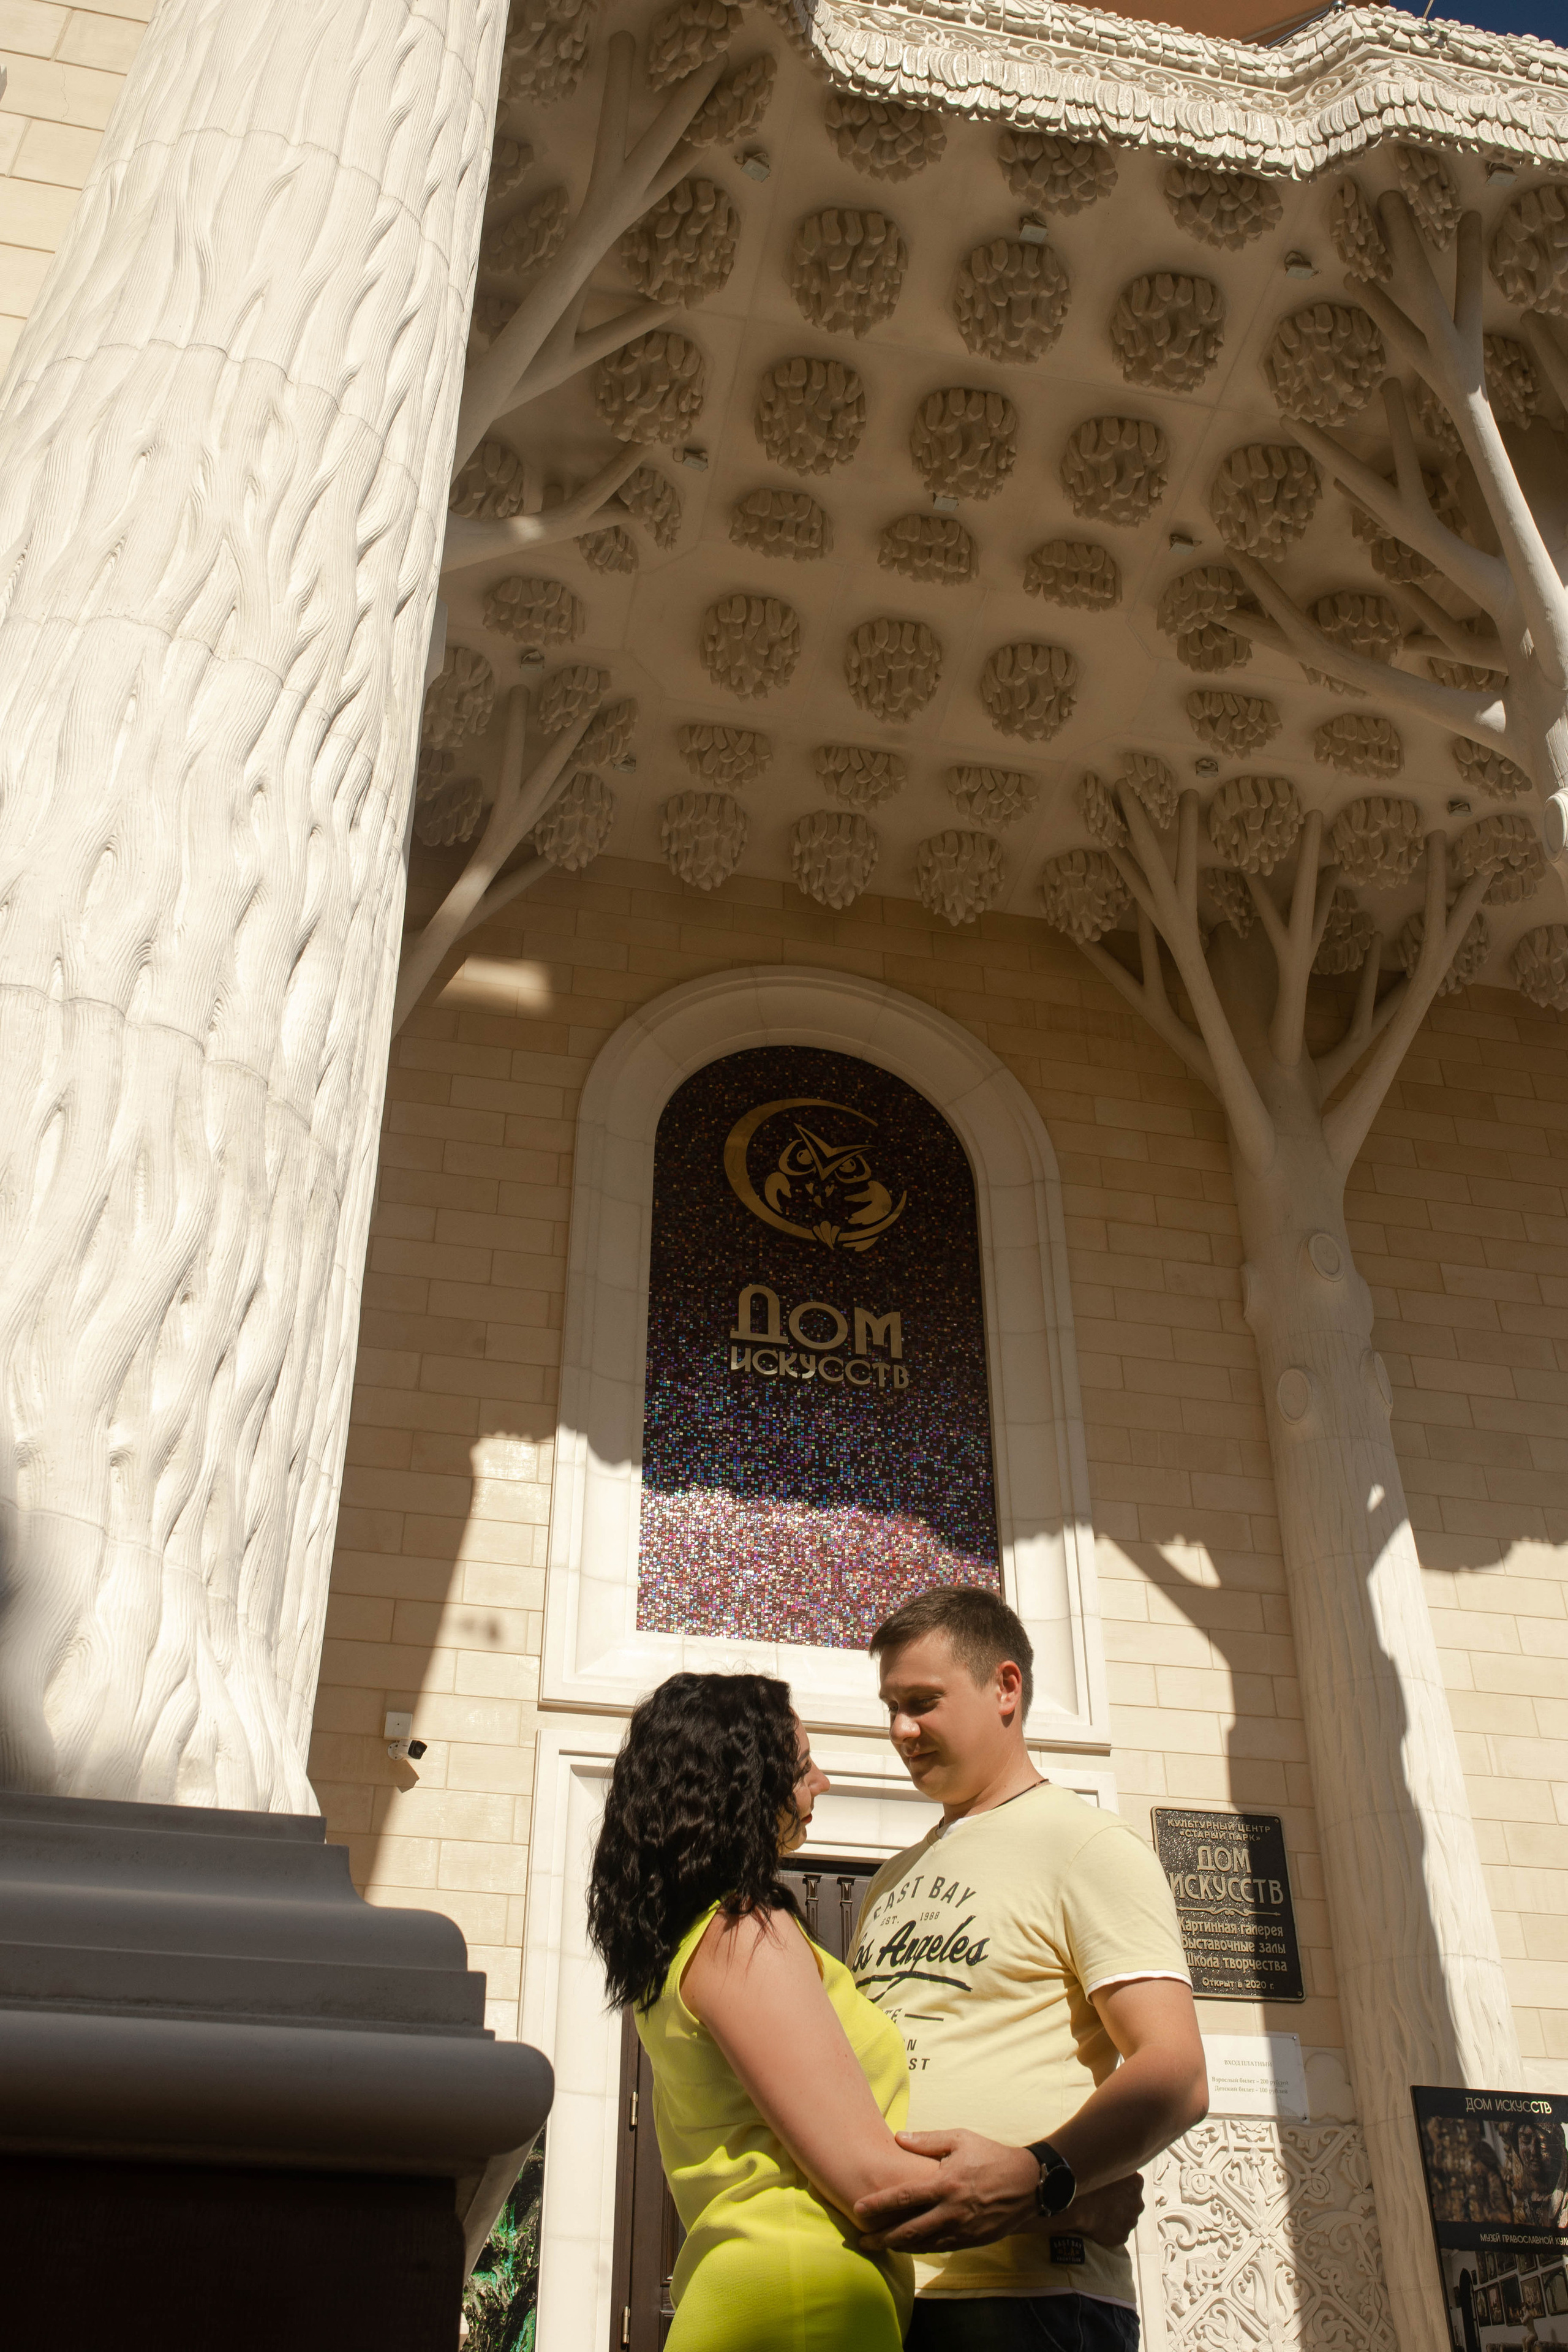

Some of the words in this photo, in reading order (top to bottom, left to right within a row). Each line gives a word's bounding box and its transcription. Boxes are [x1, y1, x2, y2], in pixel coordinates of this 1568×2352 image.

[730, 1284, 903, 1359] ДОМ
[731, 1346, 910, 1389] ИСКУССТВ
[1167, 1819, 1235, 1831] КУЛЬТУРНЫЙ
[1237, 1824, 1270, 1833] ЦЕНТР
[1180, 1830, 1225, 1839] «СТАРЫЙ
[1229, 1833, 1260, 1842] ПАРК»
[1197, 1845, 1251, 1874] ДОМ
[873, 1875, 925, 1920] EAST
[929, 1875, 976, 1908] BAY
[1168, 1872, 1284, 1904] ИСКУССТВ
[880, 1915, 899, 1926] EST.
[920, 1912, 940, 1921] 1988
[1178, 1916, 1237, 1936] Картинная
[1240, 1924, 1284, 1939] галерея
[876, 1915, 990, 1972] Angeles
[1181, 1934, 1255, 1953] Выставочные
[1259, 1942, 1286, 1954] залы
[1185, 1951, 1220, 1968] Школа
[1223, 1958, 1287, 1973] творчества
[1202, 1977, 1234, 1988] Открыт
[1245, 1980, 1266, 1989] 2020
[1465, 2097, 1492, 2113] ДОМ
[1494, 2099, 1552, 2114] ИСКУССТВ
[1480, 2233, 1501, 2242] МУЗЕЙ
[1502, 2234, 1554, 2245] ПРАВОСЛАВНОЙ
